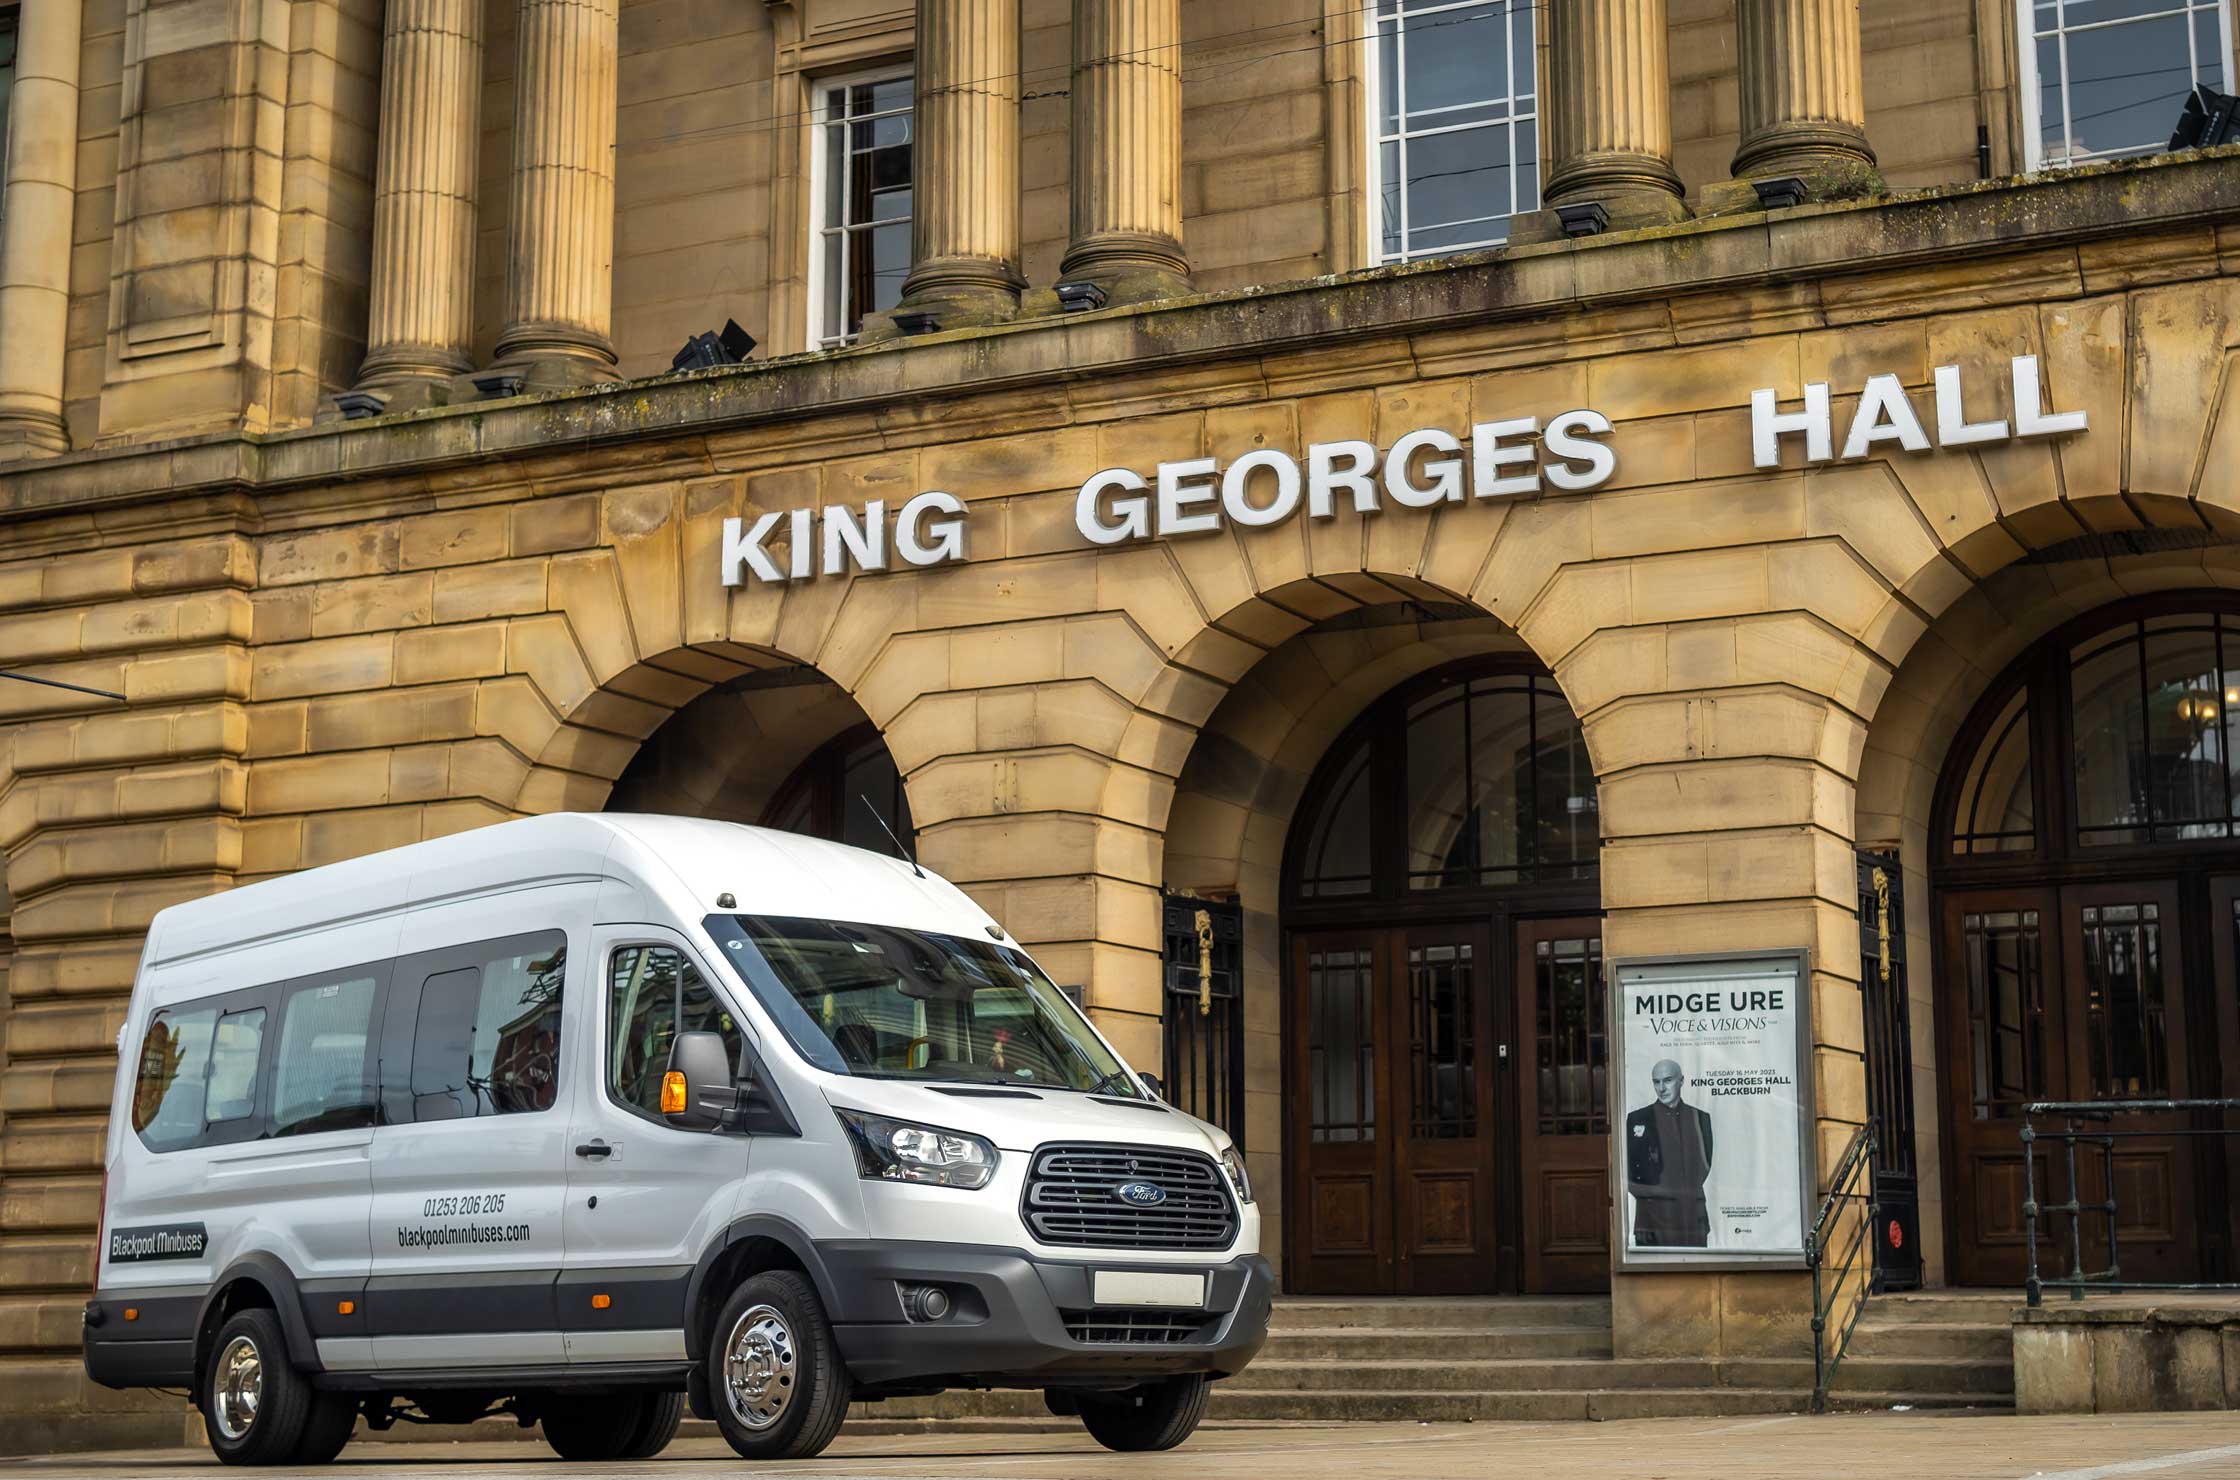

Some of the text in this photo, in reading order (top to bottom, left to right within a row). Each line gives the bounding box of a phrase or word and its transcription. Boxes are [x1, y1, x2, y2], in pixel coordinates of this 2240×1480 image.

[721, 354, 2089, 587] KING GEORGES HALL
[1635, 990, 1784, 1015] MIDGE URE
[1650, 1016, 1767, 1034] VOICE & VISIONS
[1690, 1076, 1791, 1087] KING GEORGES HALL
[1711, 1087, 1771, 1096] BLACKBURN
[1132, 1185, 1158, 1201] Ford
[423, 1194, 506, 1217] 01253 206 205
[112, 1230, 202, 1259] Blackpool Minibuses
[398, 1222, 530, 1250] blackpoolminibuses.com
